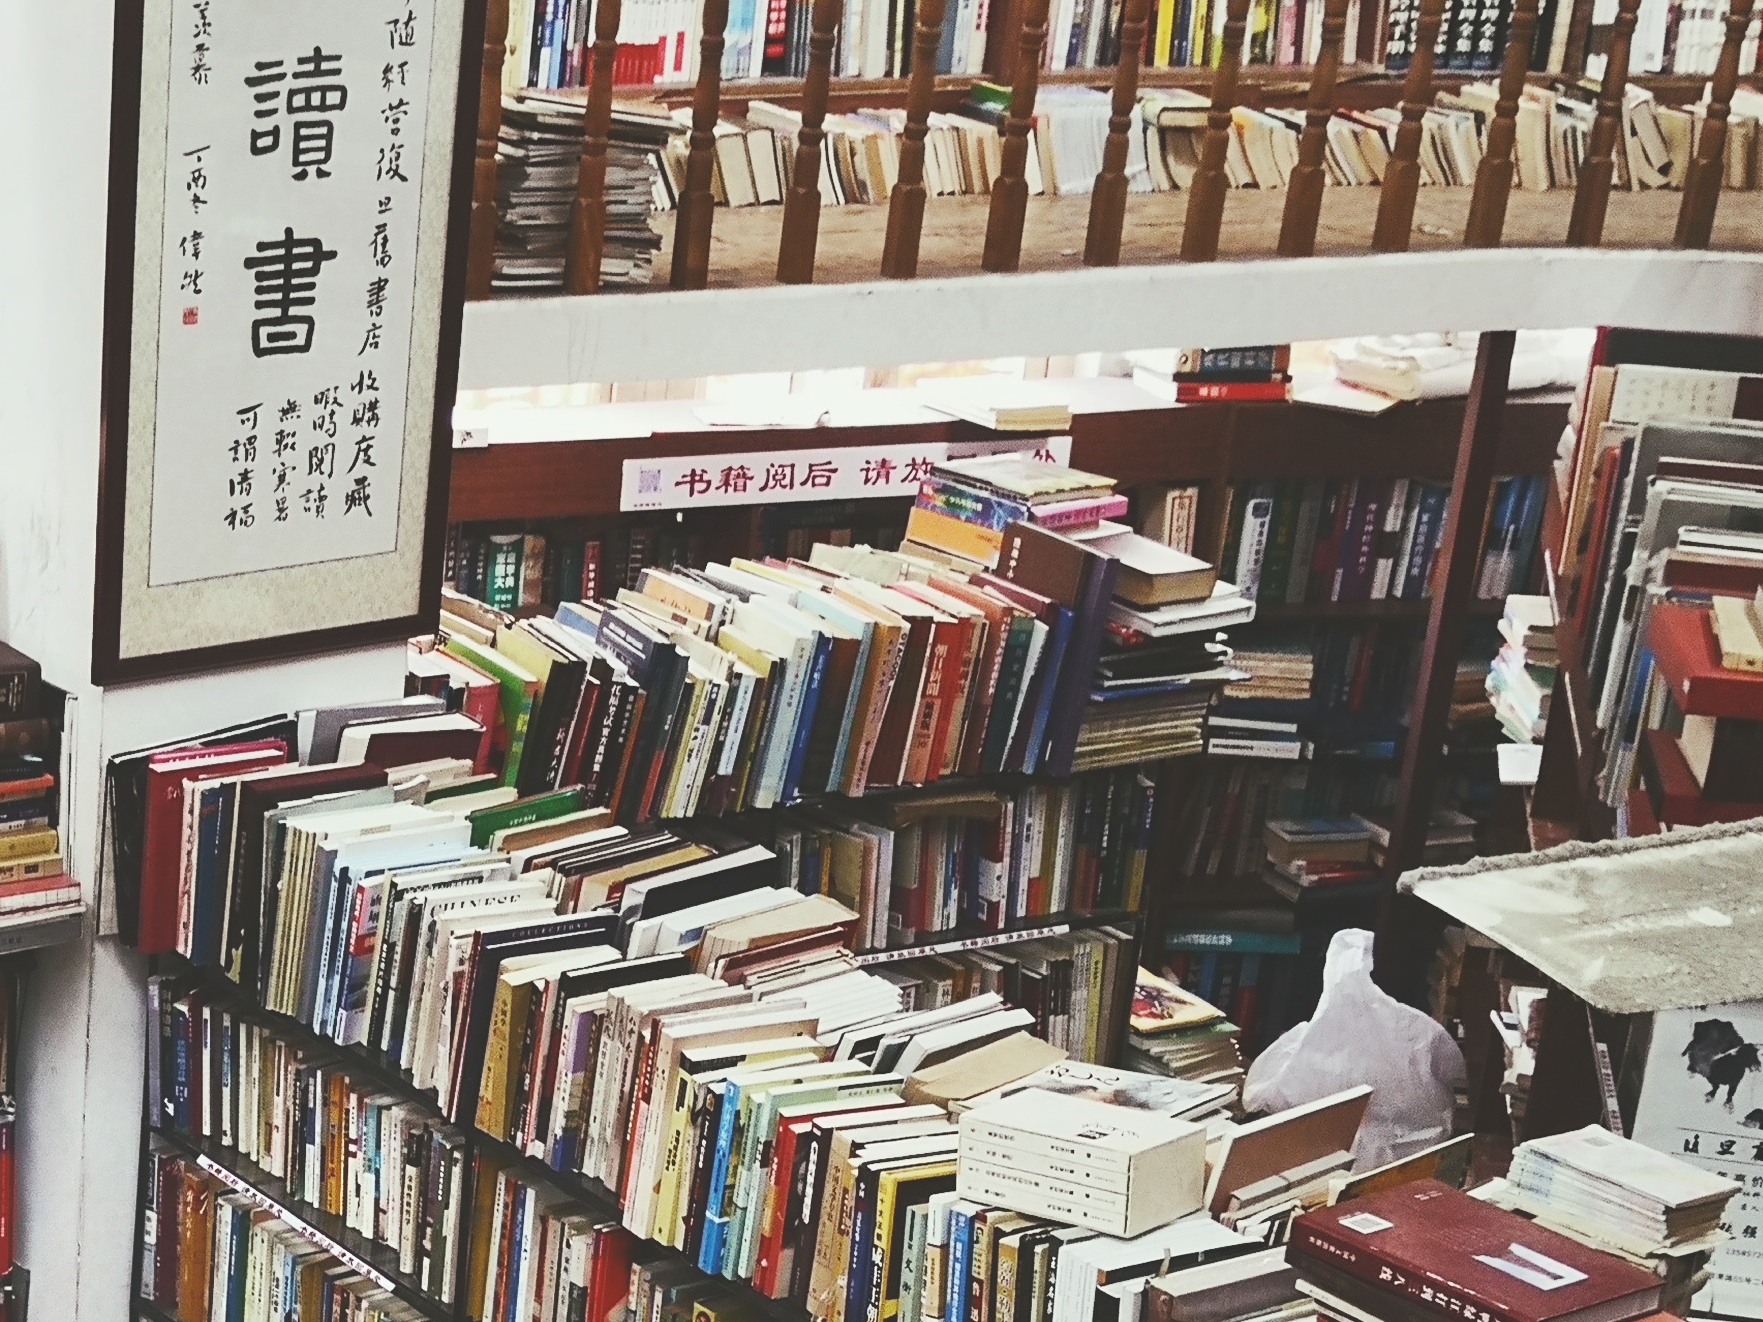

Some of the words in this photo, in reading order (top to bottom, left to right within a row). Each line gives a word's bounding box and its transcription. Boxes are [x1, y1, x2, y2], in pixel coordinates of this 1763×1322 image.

[244, 46, 347, 359] 讀書
[674, 460, 838, 498] 书籍阅后
